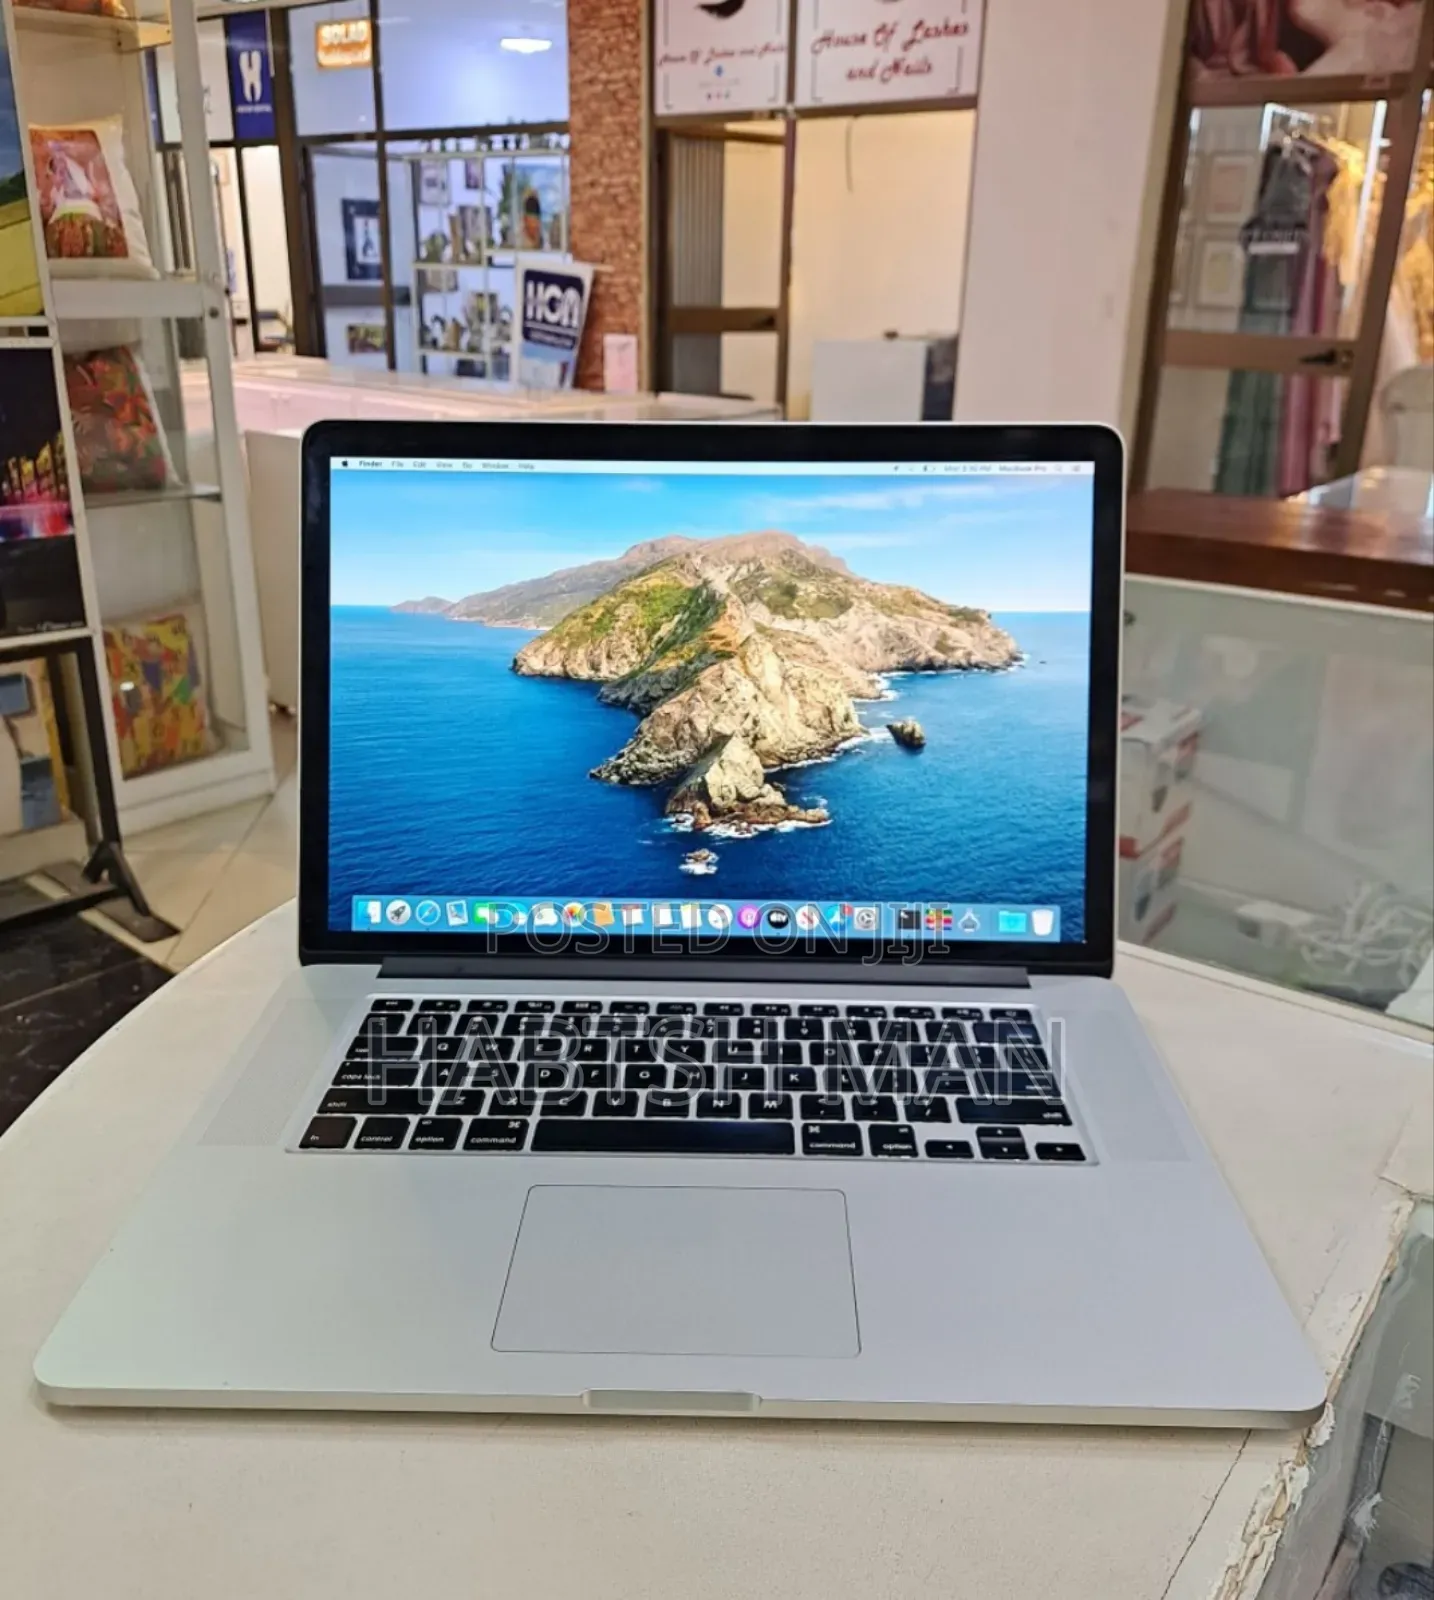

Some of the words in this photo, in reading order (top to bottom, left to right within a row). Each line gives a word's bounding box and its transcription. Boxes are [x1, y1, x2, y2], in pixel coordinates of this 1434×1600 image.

[359, 460, 383, 468] Finder
[415, 1136, 444, 1144] option
[470, 1136, 517, 1144] command
[809, 1141, 856, 1149] command
[883, 1142, 912, 1150] option
